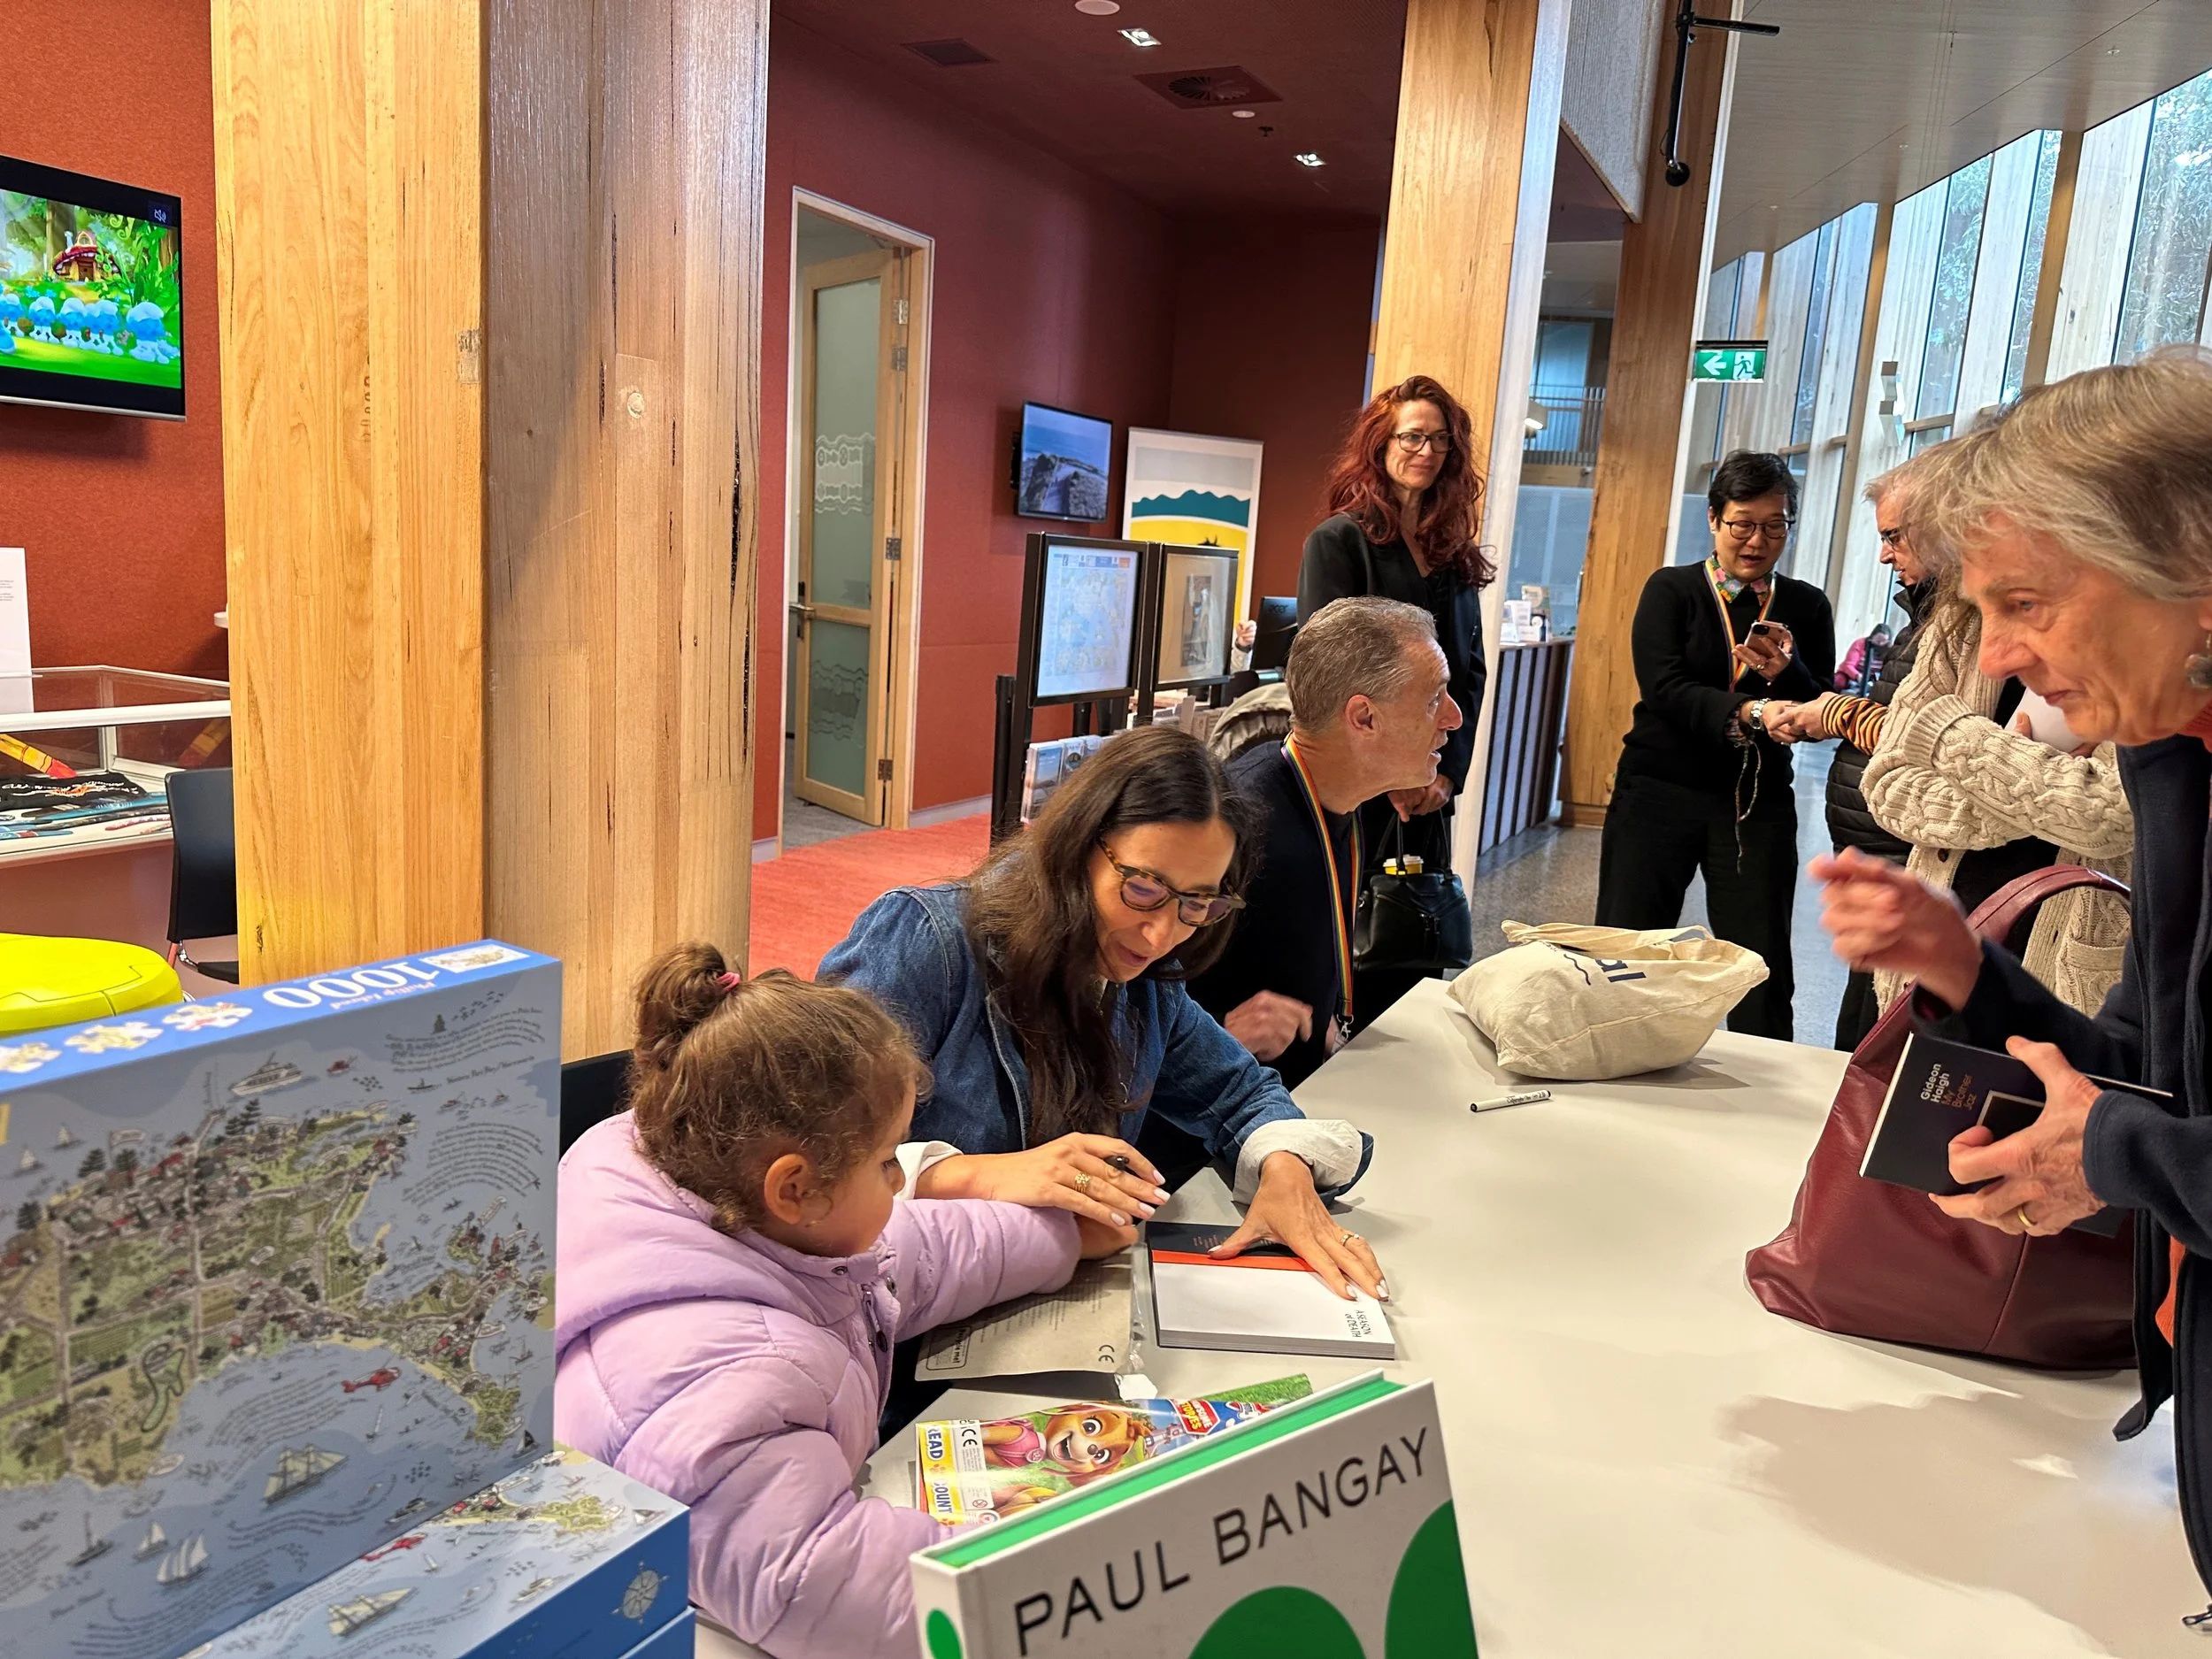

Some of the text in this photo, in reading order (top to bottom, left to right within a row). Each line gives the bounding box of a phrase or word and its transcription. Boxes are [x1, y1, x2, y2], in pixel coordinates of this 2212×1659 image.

[263, 962, 440, 1009] 1000
[329, 980, 437, 1010] Phillip Island
[1920, 1063, 1942, 1101] Gideon
[1930, 1072, 1950, 1104] Haigh
[1941, 1090, 1955, 1105] My
[1952, 1073, 1973, 1109] Brother
[1963, 1094, 1977, 1110] Jaz
[1347, 1319, 1362, 1338] DEATH
[1356, 1314, 1372, 1335] SEASON
[1181, 1401, 1202, 1430] TORIES
[933, 1481, 953, 1514] OUNT
[1014, 1427, 1429, 1658] PAUL BANGAY
